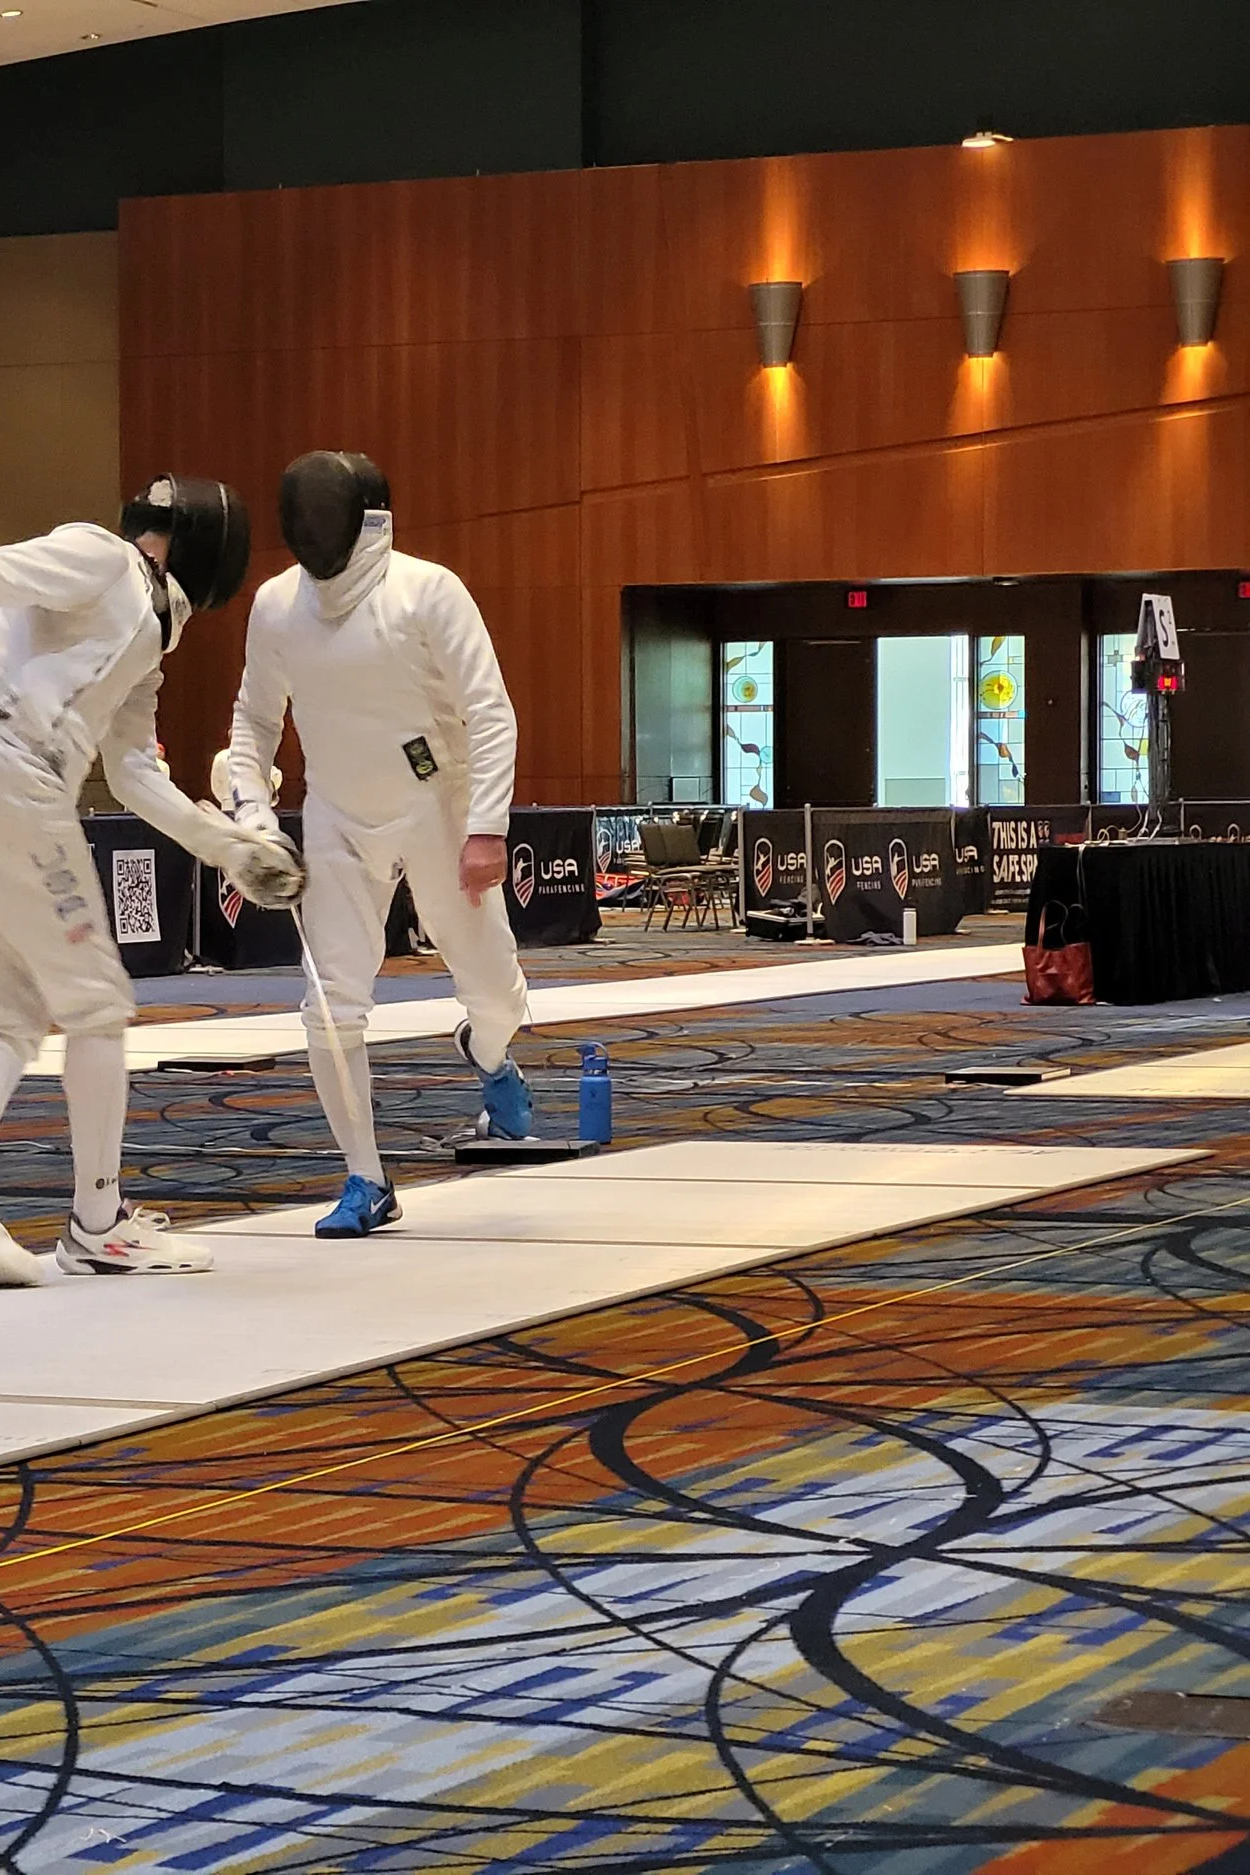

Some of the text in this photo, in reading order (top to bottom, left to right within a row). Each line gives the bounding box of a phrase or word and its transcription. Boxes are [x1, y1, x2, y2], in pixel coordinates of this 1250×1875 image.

[1159, 609, 1169, 648] S
[992, 821, 1038, 849] THIS IS A
[616, 839, 640, 854] USA
[541, 859, 579, 880] USA
[777, 852, 806, 871] USA
[851, 855, 882, 876] USA
[912, 853, 940, 873] USA
[993, 854, 1021, 883] SAFE
[538, 883, 585, 895] PARAFENCING
